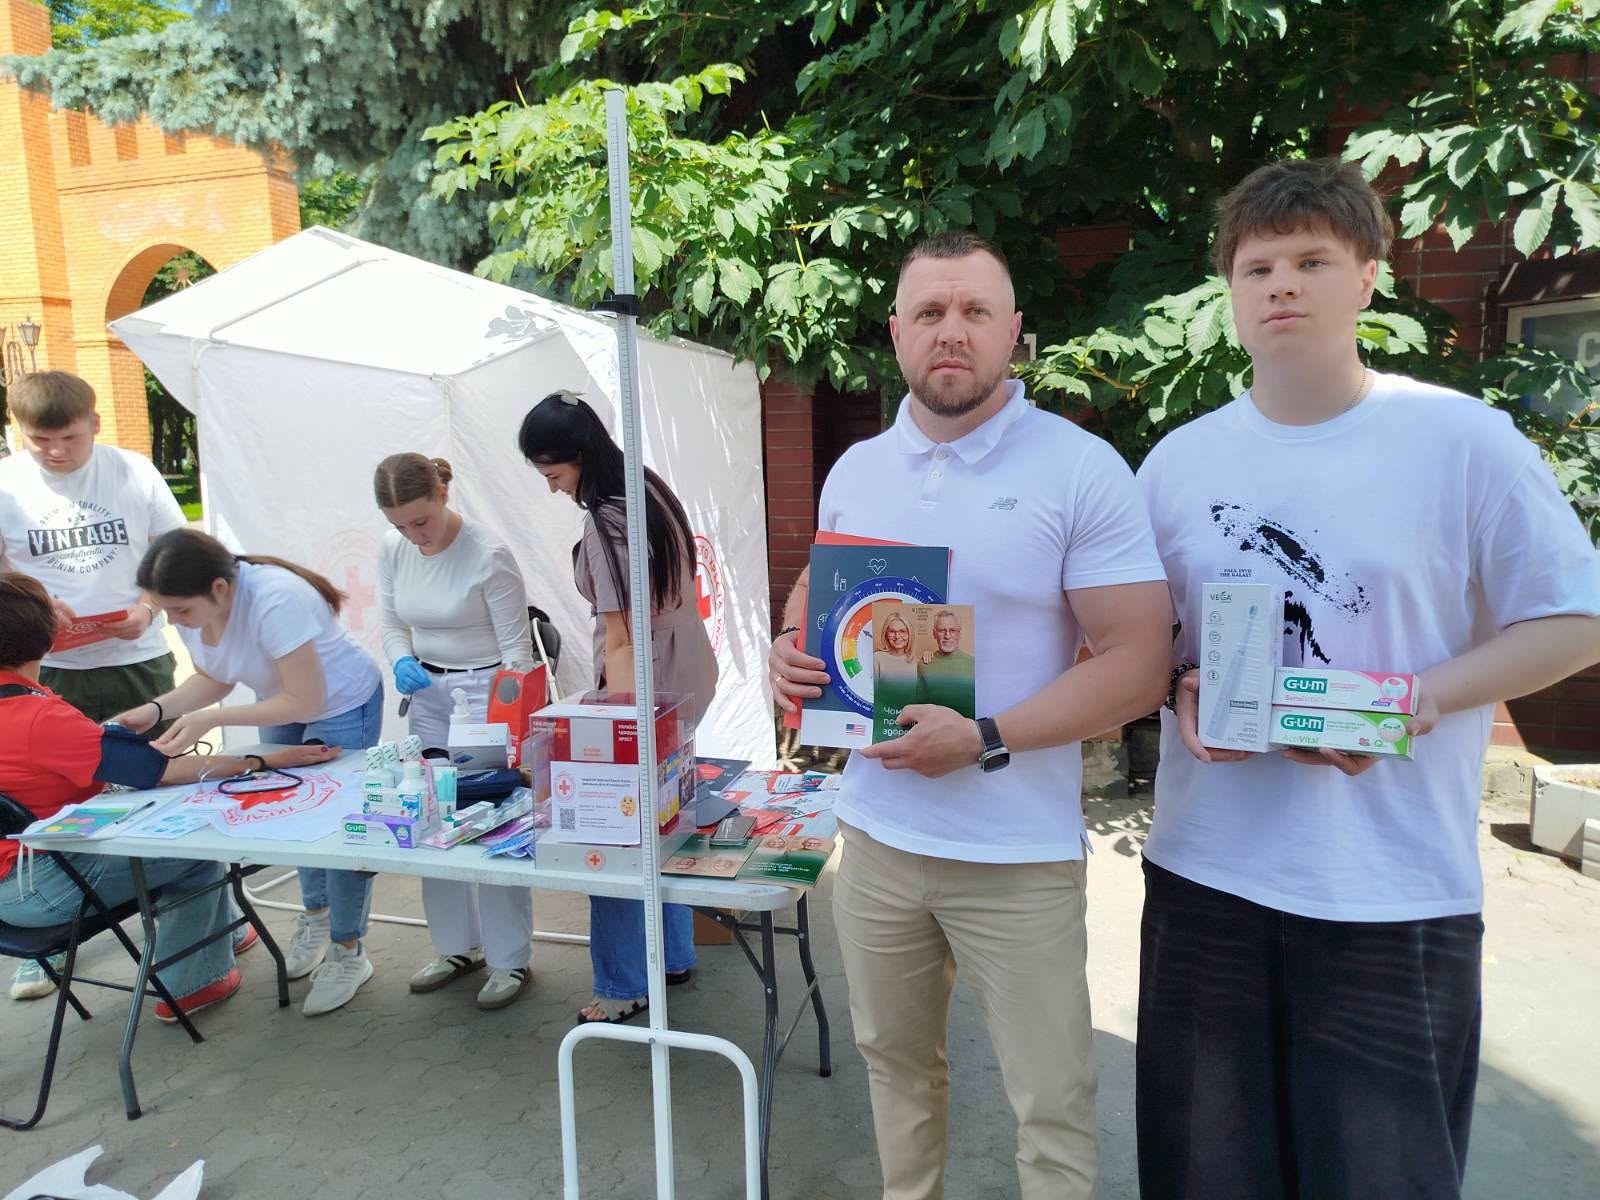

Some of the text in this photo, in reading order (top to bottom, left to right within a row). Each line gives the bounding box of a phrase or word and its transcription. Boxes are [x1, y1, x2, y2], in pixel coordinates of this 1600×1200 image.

[29, 520, 128, 555] VINTAGE
[79, 547, 119, 574] COMPANY
[1210, 592, 1232, 601] VEGA
[883, 706, 902, 715] Чом
